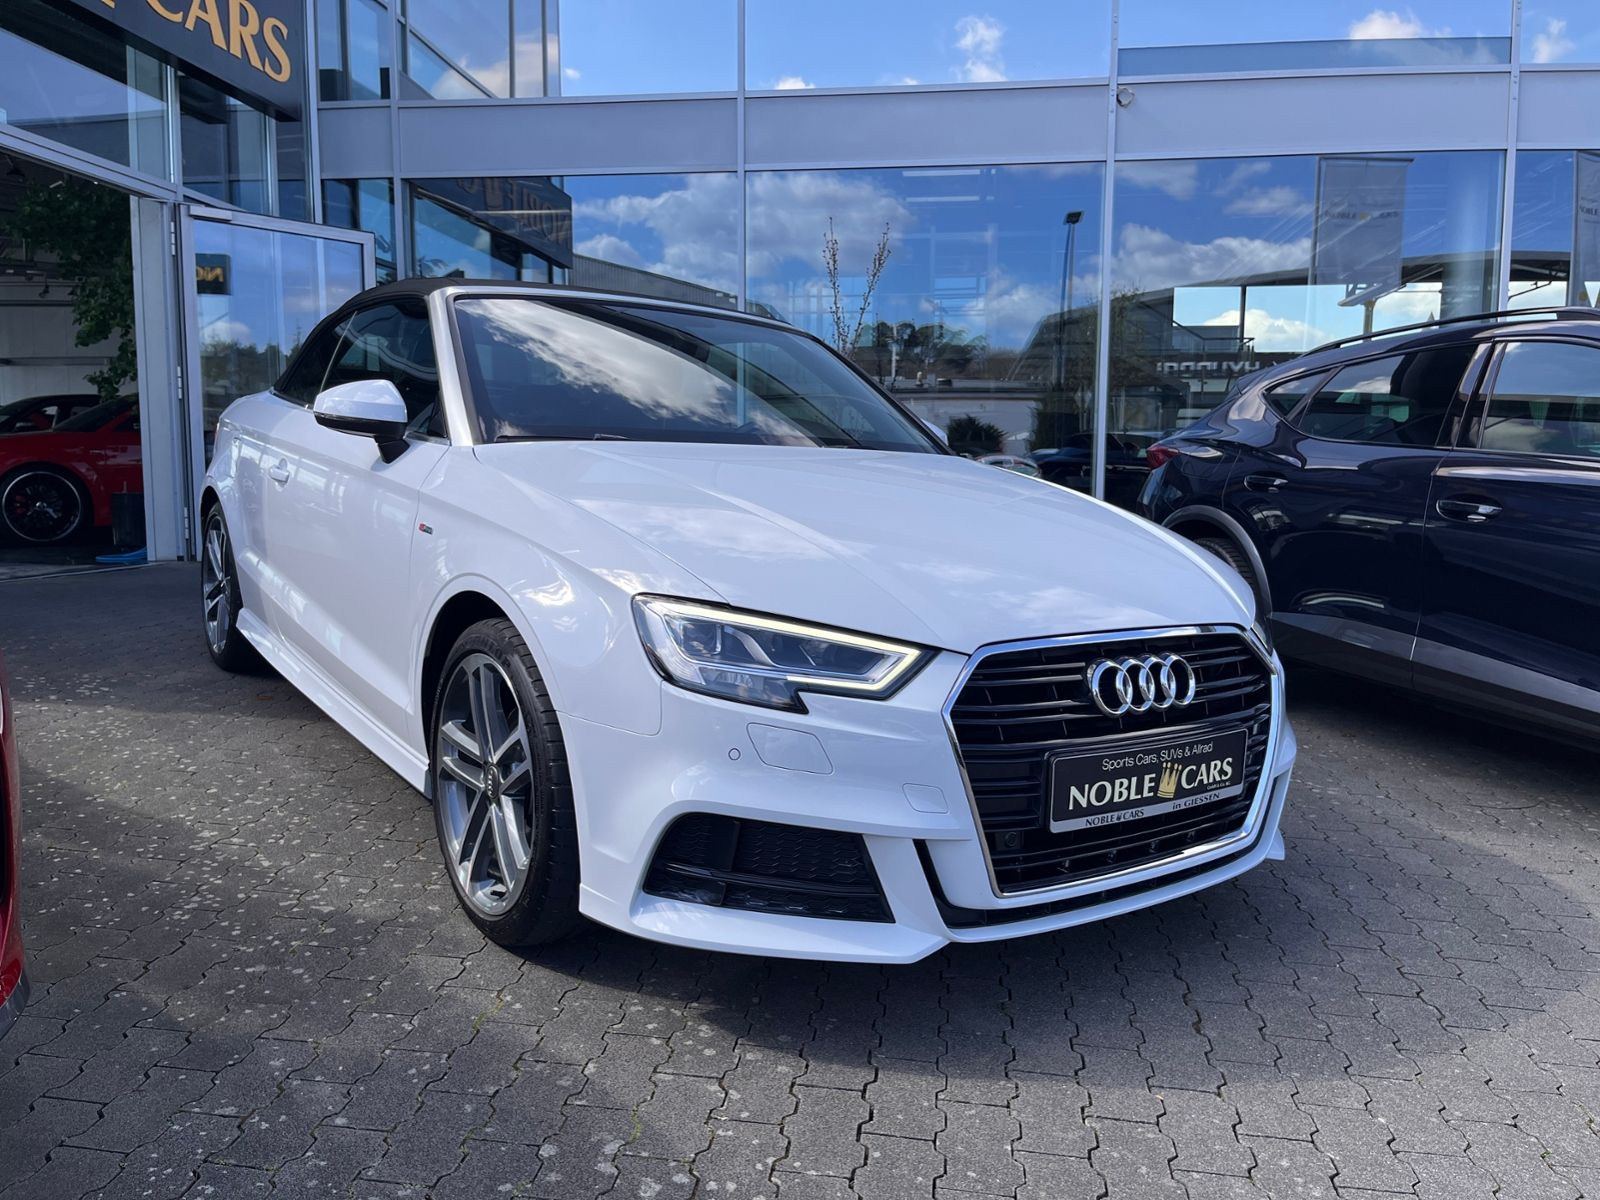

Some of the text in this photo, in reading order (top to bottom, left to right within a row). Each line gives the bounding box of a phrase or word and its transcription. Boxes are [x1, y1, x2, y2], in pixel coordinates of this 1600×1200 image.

[1102, 757, 1135, 771] Sports
[1136, 753, 1159, 765] Cars,
[1160, 747, 1183, 761] SUVs
[1184, 746, 1191, 757] &
[1068, 757, 1233, 810] NOBLE CARS
[1085, 792, 1220, 827] NOBLE CARS in GIESSEN
